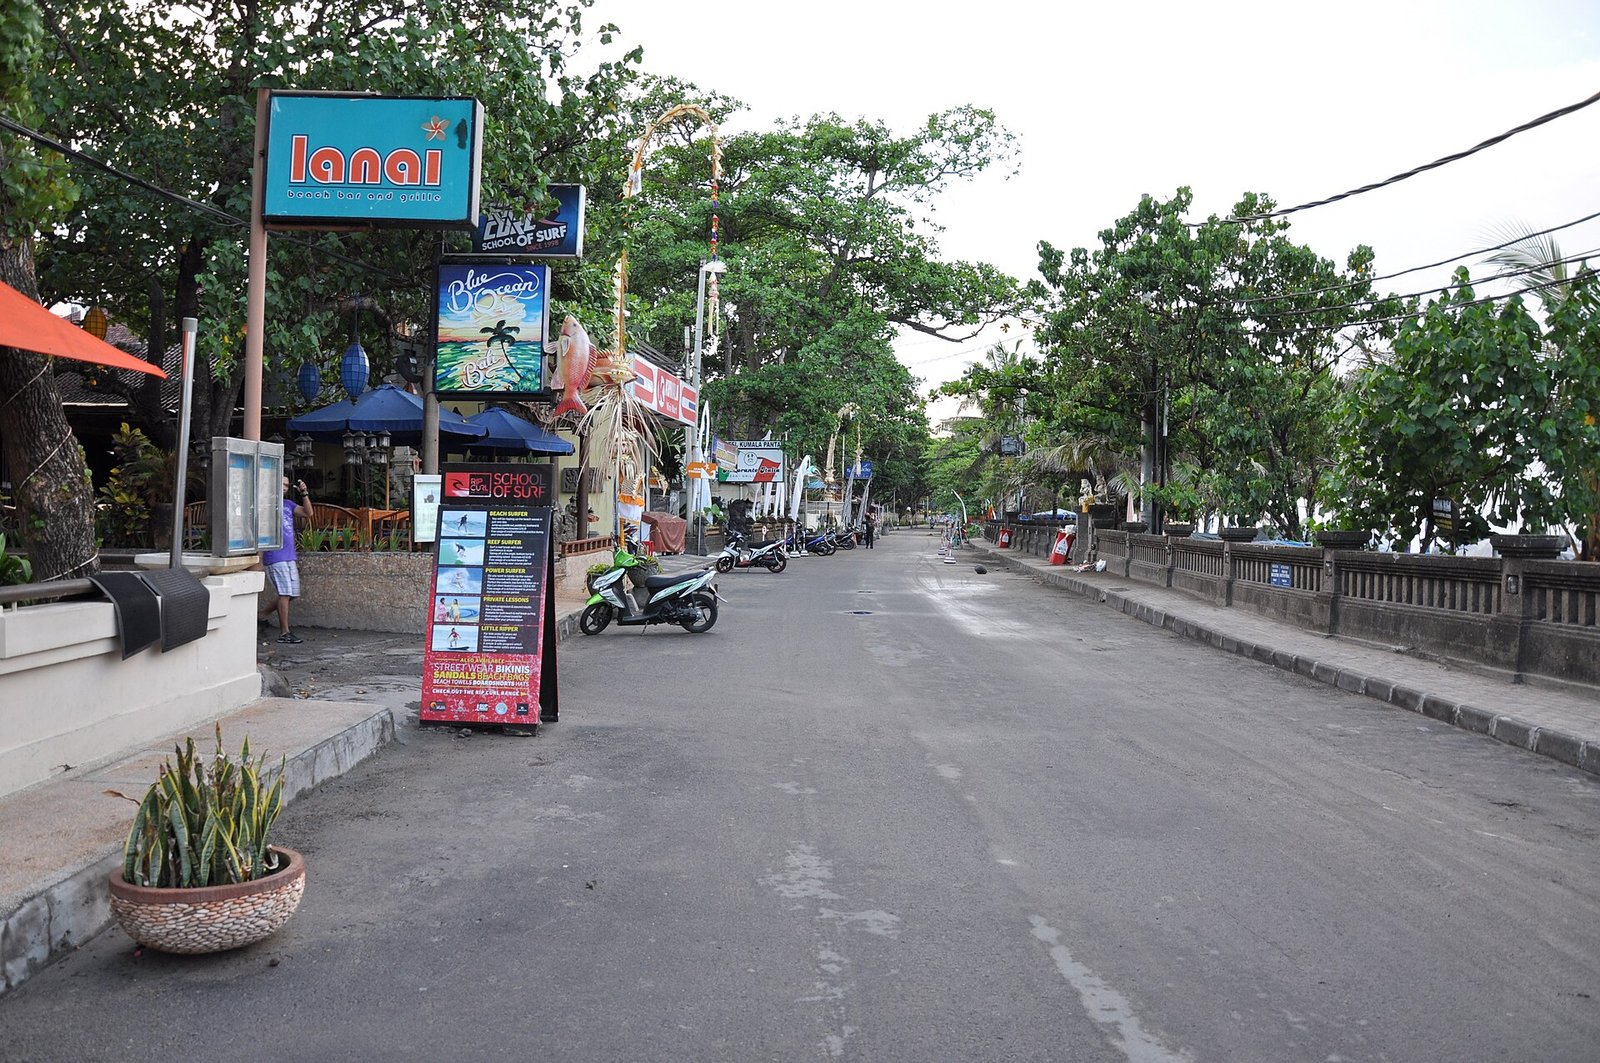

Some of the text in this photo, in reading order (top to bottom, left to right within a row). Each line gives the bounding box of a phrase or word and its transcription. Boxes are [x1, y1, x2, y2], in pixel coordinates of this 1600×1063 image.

[290, 134, 442, 186] lanai
[287, 190, 442, 202] beach bar and grille
[482, 225, 567, 251] SCHOOL OF SURF
[447, 269, 500, 314] Blue
[474, 280, 539, 314] Ocean
[494, 473, 546, 485] SCHOOL
[493, 486, 546, 498] OF SURF
[433, 671, 477, 679] SANDALS
[495, 665, 530, 674] BIKINIS
